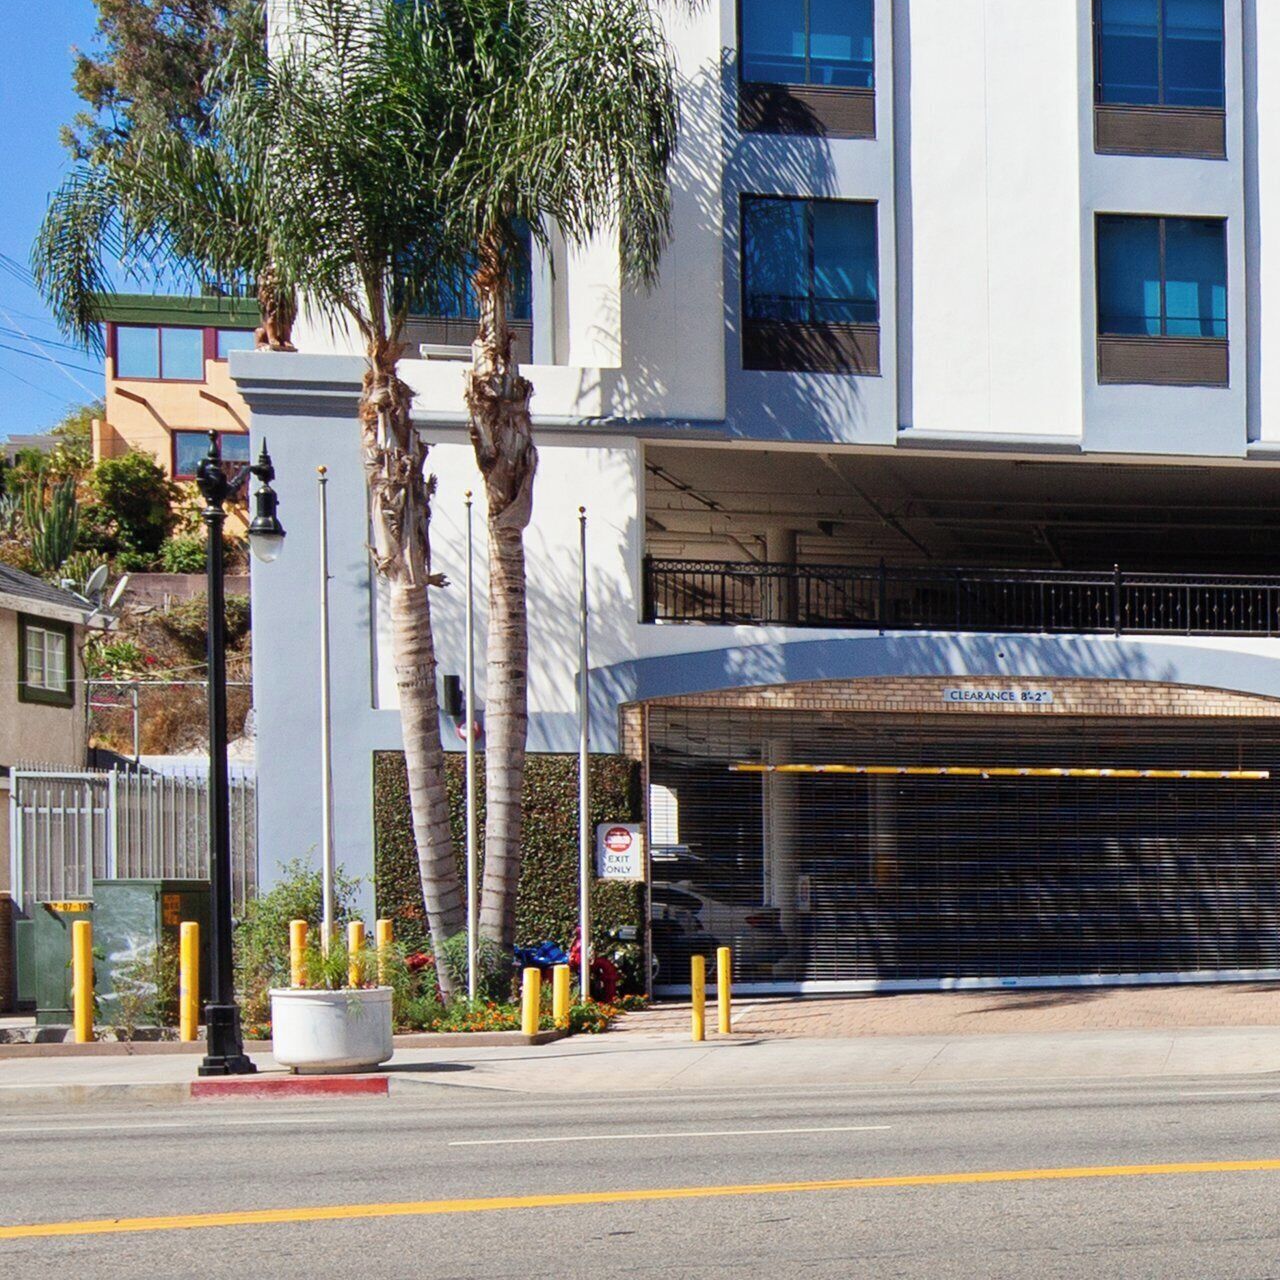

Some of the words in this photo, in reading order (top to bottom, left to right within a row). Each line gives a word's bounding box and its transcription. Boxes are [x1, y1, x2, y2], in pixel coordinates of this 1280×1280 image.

[950, 690, 1015, 701] CLEARANCE
[608, 855, 630, 863] EXIT
[606, 865, 632, 874] ONLY
